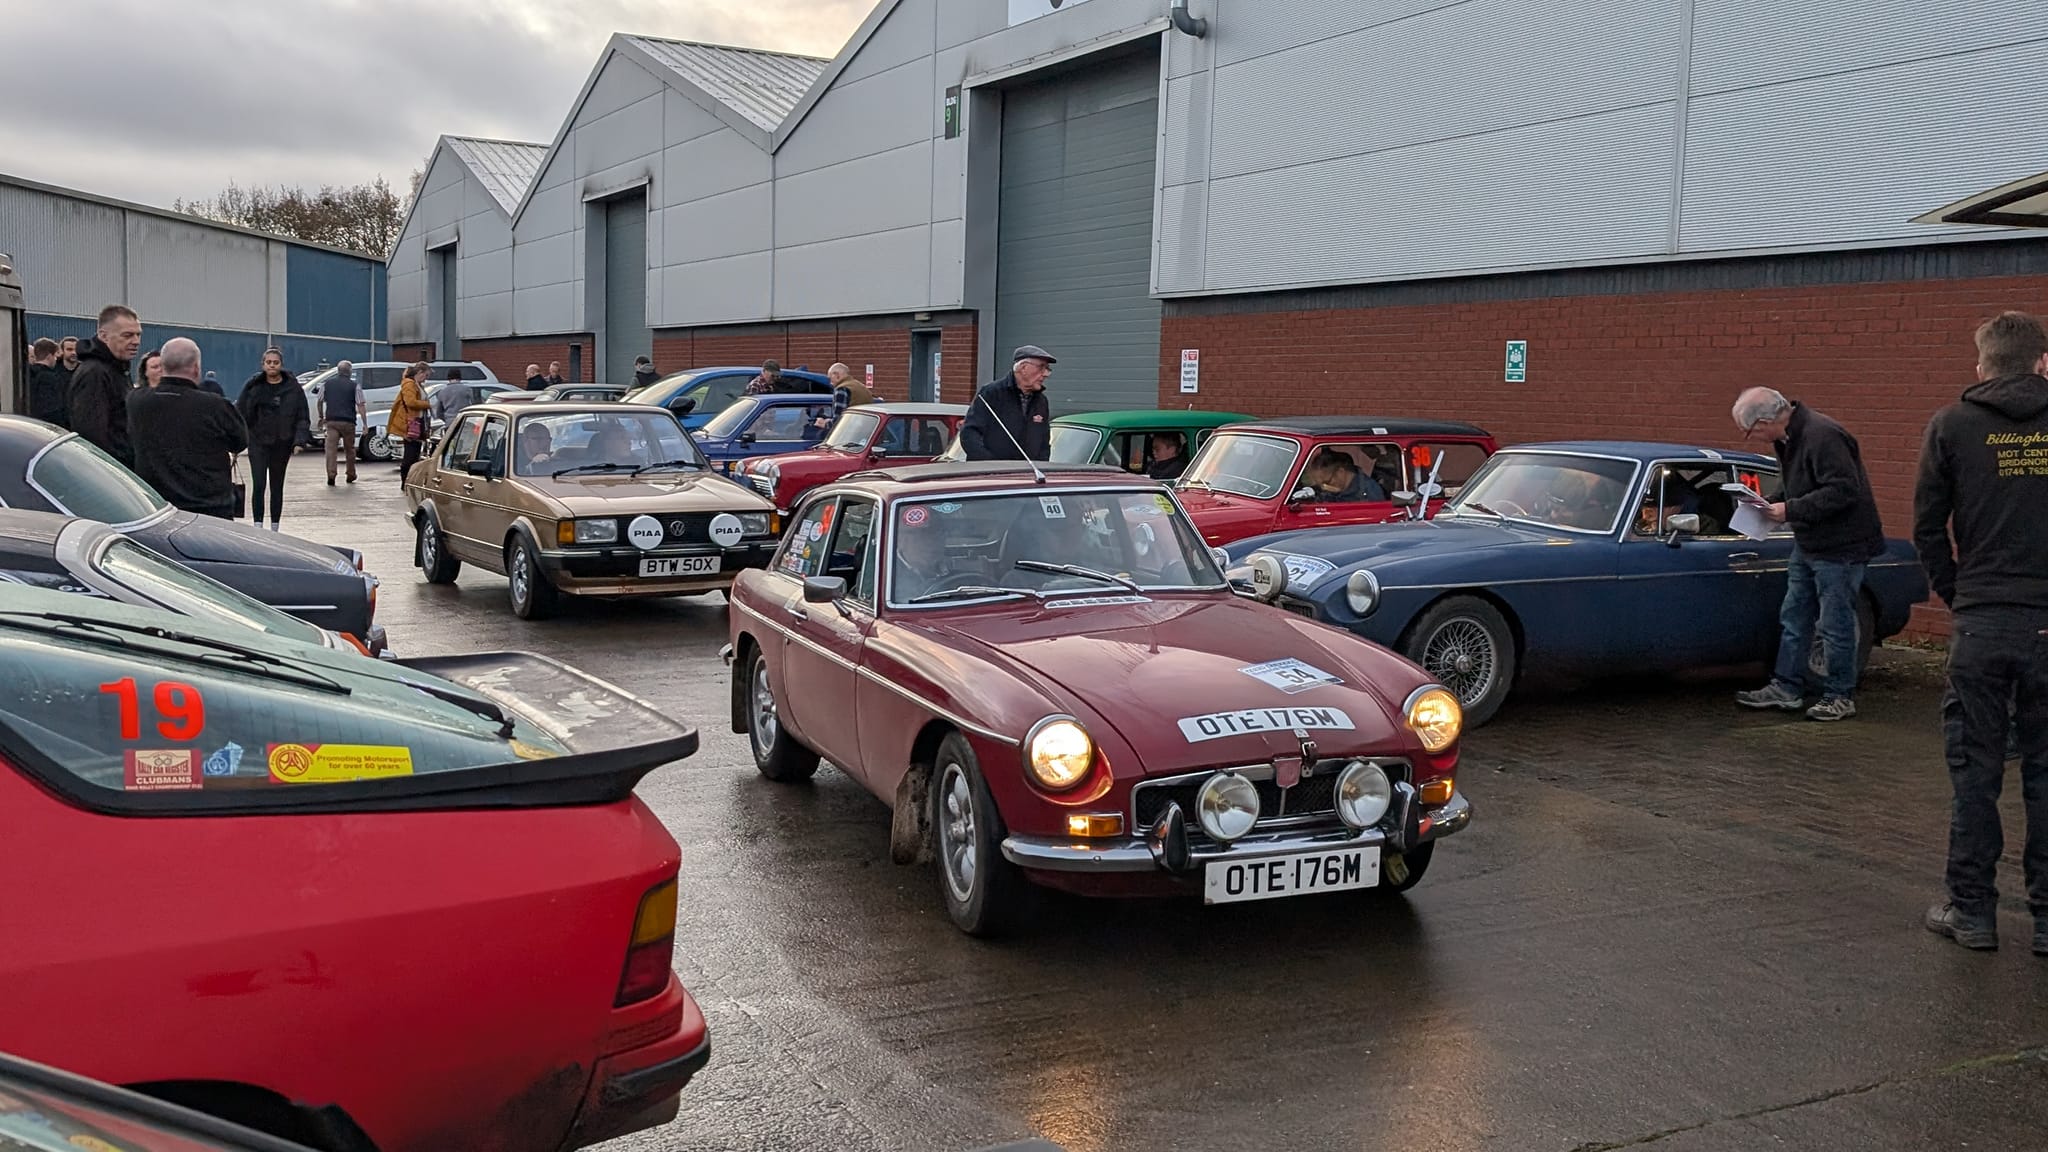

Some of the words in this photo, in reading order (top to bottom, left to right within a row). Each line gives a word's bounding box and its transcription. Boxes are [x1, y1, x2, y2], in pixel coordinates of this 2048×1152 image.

[1410, 446, 1431, 467] 36
[1998, 450, 2019, 458] MOT
[1046, 504, 1061, 514] 40
[715, 527, 741, 535] PIAA
[647, 559, 679, 573] BTW
[1276, 668, 1318, 684] 54
[98, 676, 205, 741] 19
[1196, 711, 1264, 736] OTE
[1264, 708, 1338, 728] 176M
[317, 755, 362, 763] Promoting
[364, 755, 409, 763] Motorsport
[136, 776, 193, 785] CLUBMANS
[1225, 861, 1286, 896] OTE
[1295, 853, 1361, 889] 176M
